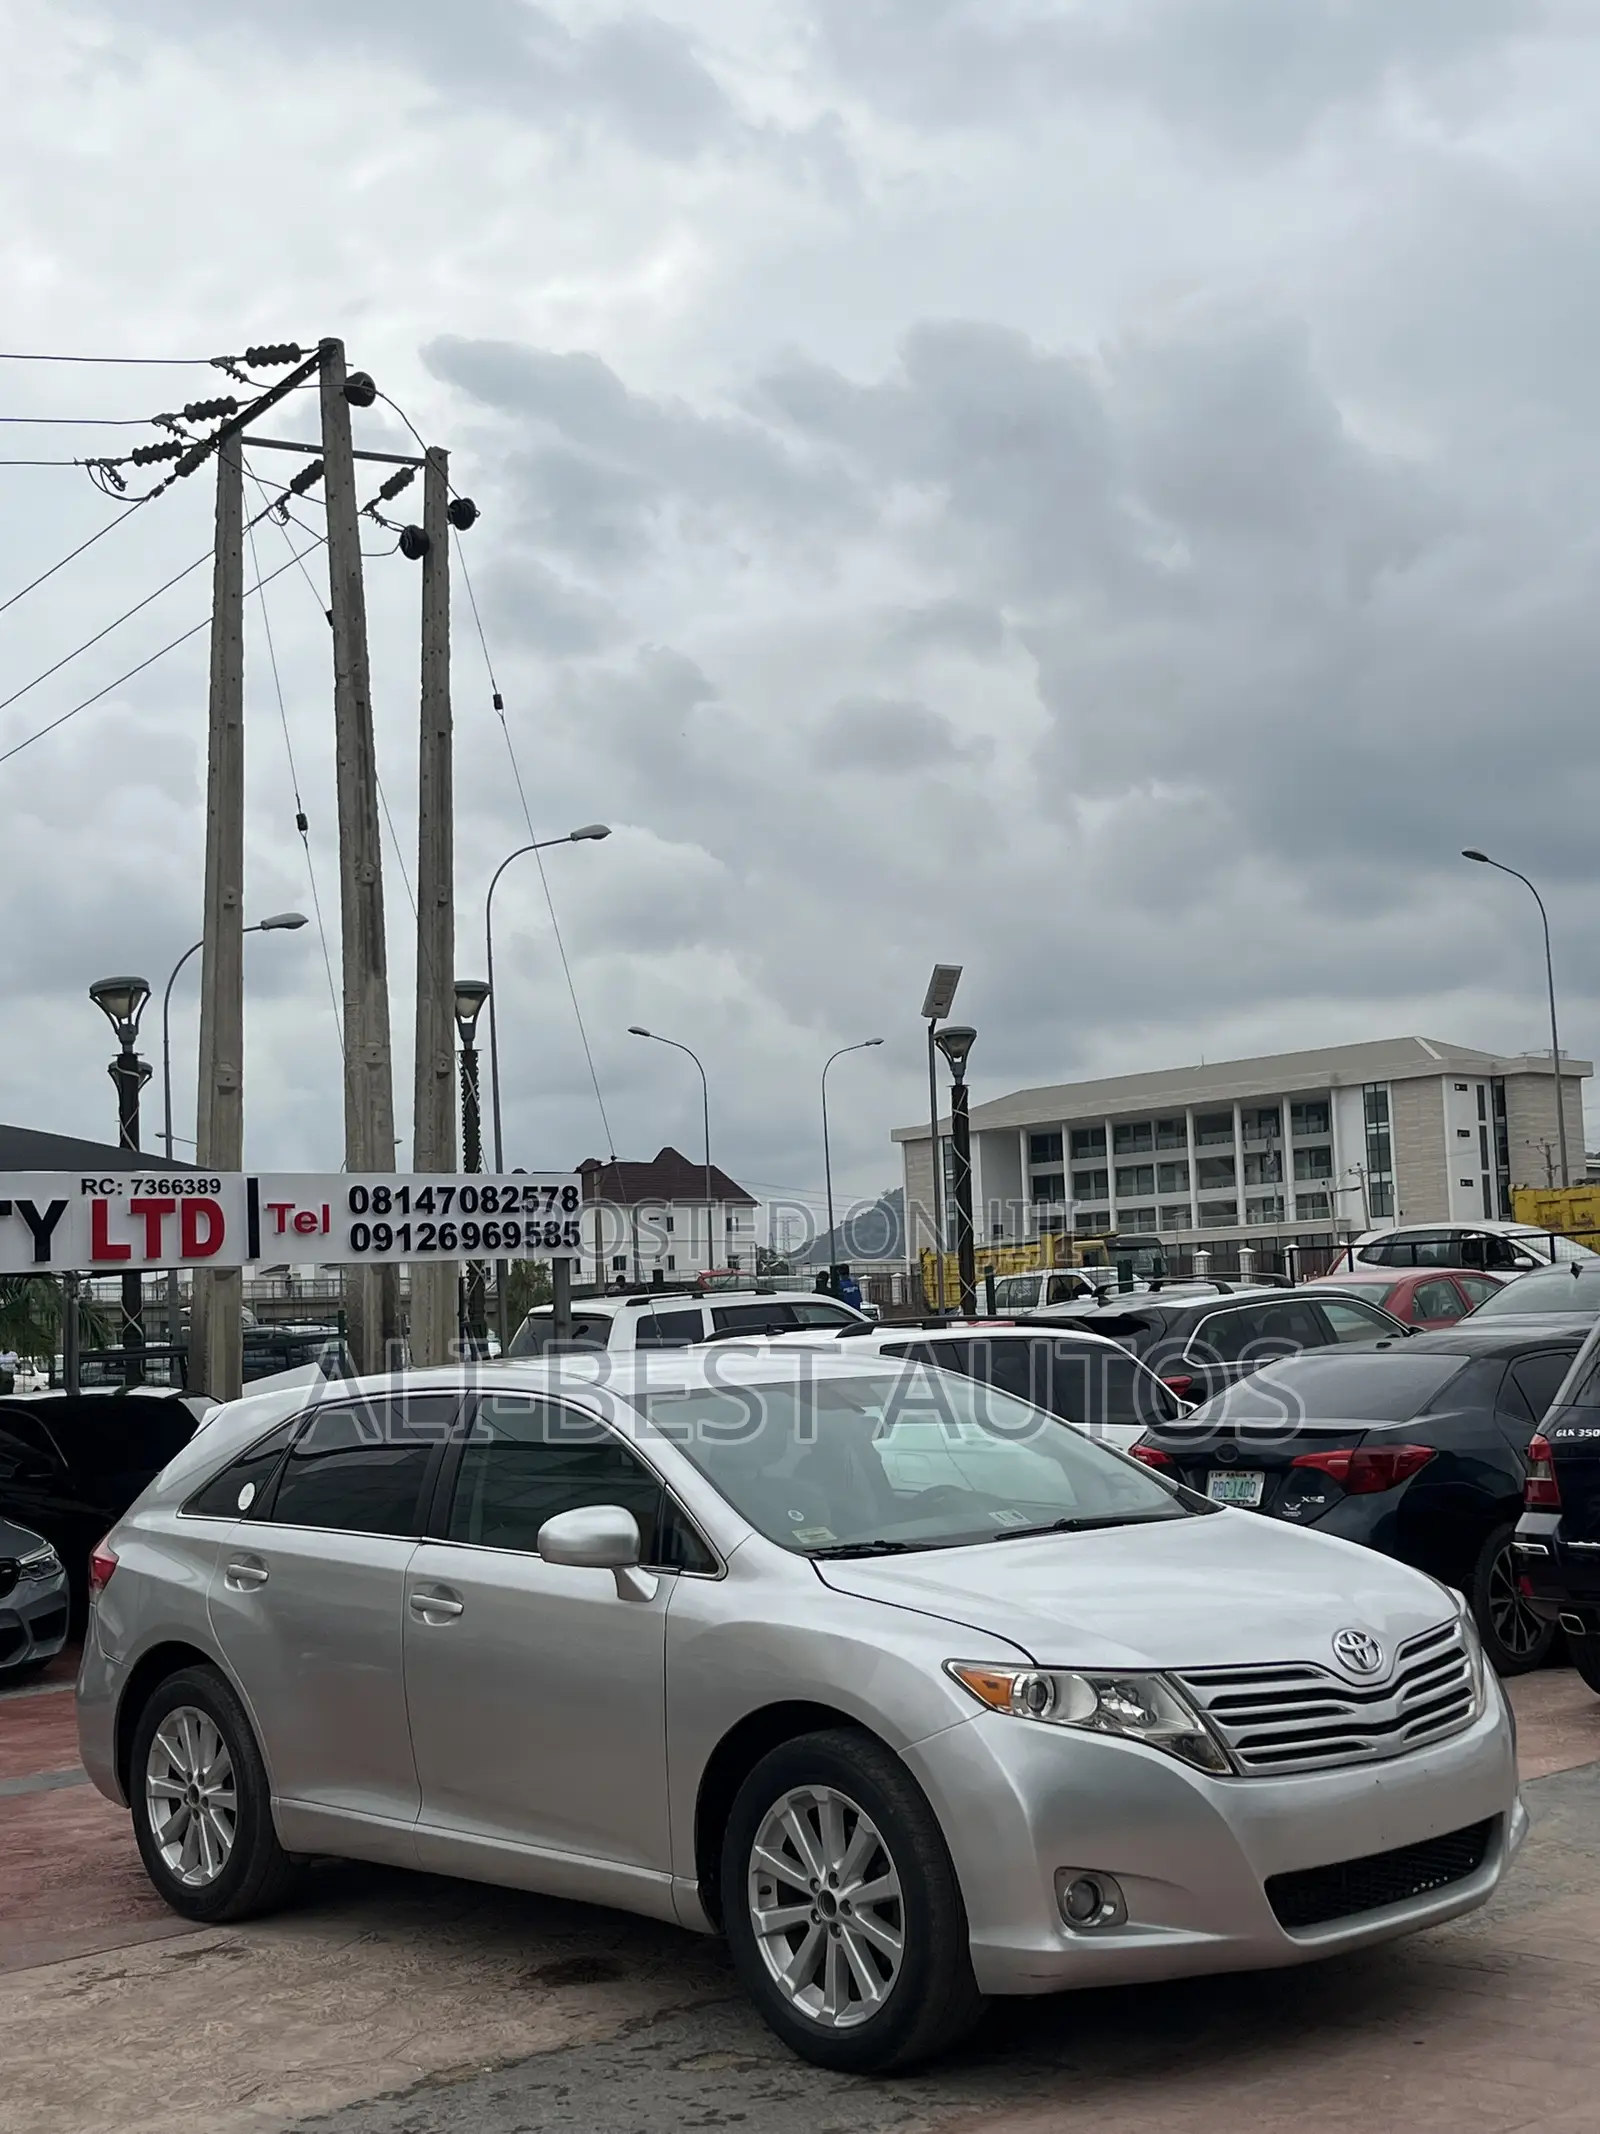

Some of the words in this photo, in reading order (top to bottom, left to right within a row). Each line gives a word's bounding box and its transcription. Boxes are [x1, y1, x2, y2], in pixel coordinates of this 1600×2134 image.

[81, 1178, 123, 1195] RC:
[130, 1178, 221, 1195] 7366389
[349, 1185, 580, 1215] 08147082578
[0, 1200, 69, 1262] Y
[91, 1198, 226, 1261] LTD
[266, 1203, 330, 1234] Tel
[350, 1220, 581, 1252] 09126969585
[1555, 1428, 1576, 1437] GLK
[1578, 1428, 1600, 1437] 350
